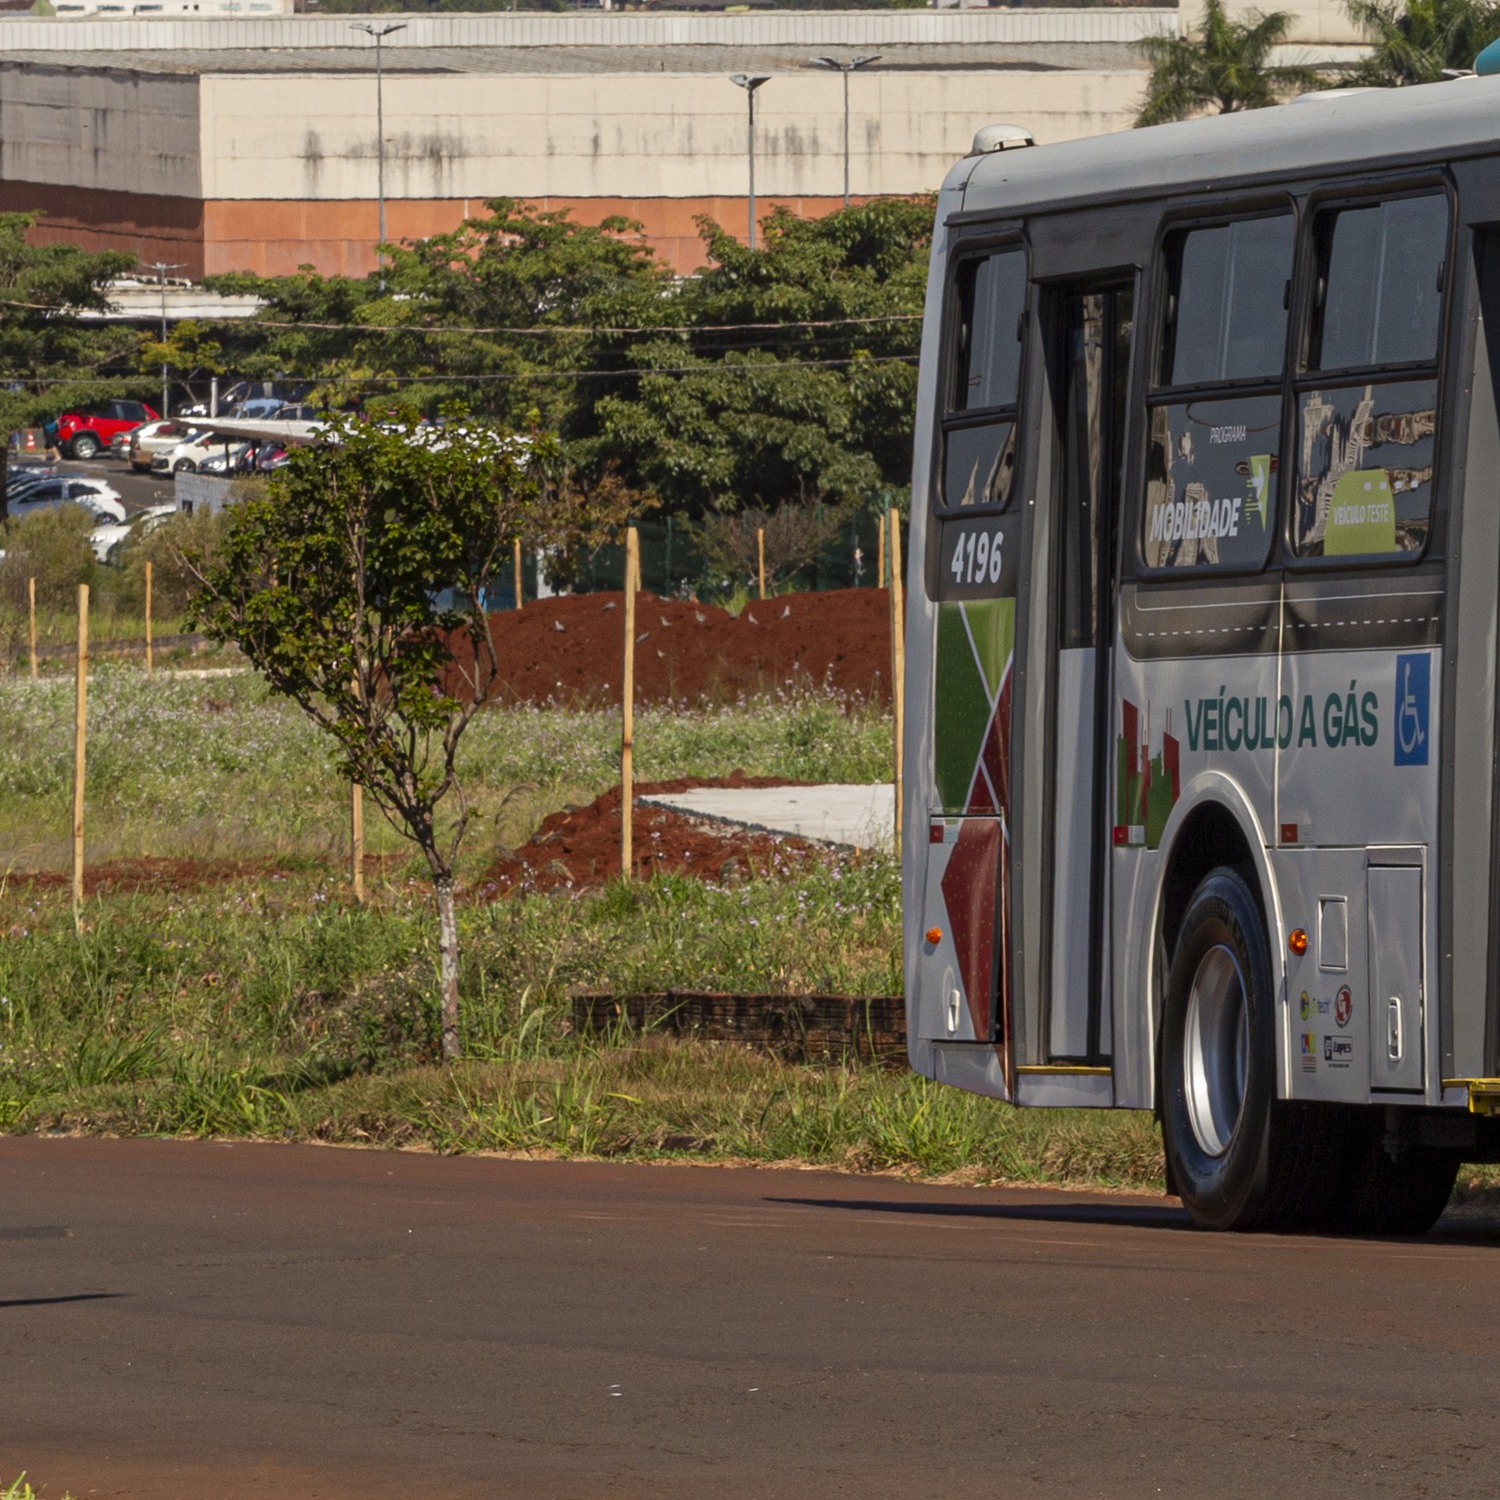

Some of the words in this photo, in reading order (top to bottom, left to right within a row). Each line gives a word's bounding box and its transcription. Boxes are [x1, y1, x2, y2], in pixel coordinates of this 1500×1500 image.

[1209, 425, 1247, 444] PROGRAMA
[1150, 497, 1242, 543] MOBILIDADE
[1333, 501, 1365, 526] VEÍCULO
[1365, 503, 1389, 523] TESTE
[951, 531, 1004, 584] 4196
[1184, 685, 1294, 752] VEÍCULO
[1297, 695, 1317, 748] A
[1323, 679, 1379, 749] GÁS
